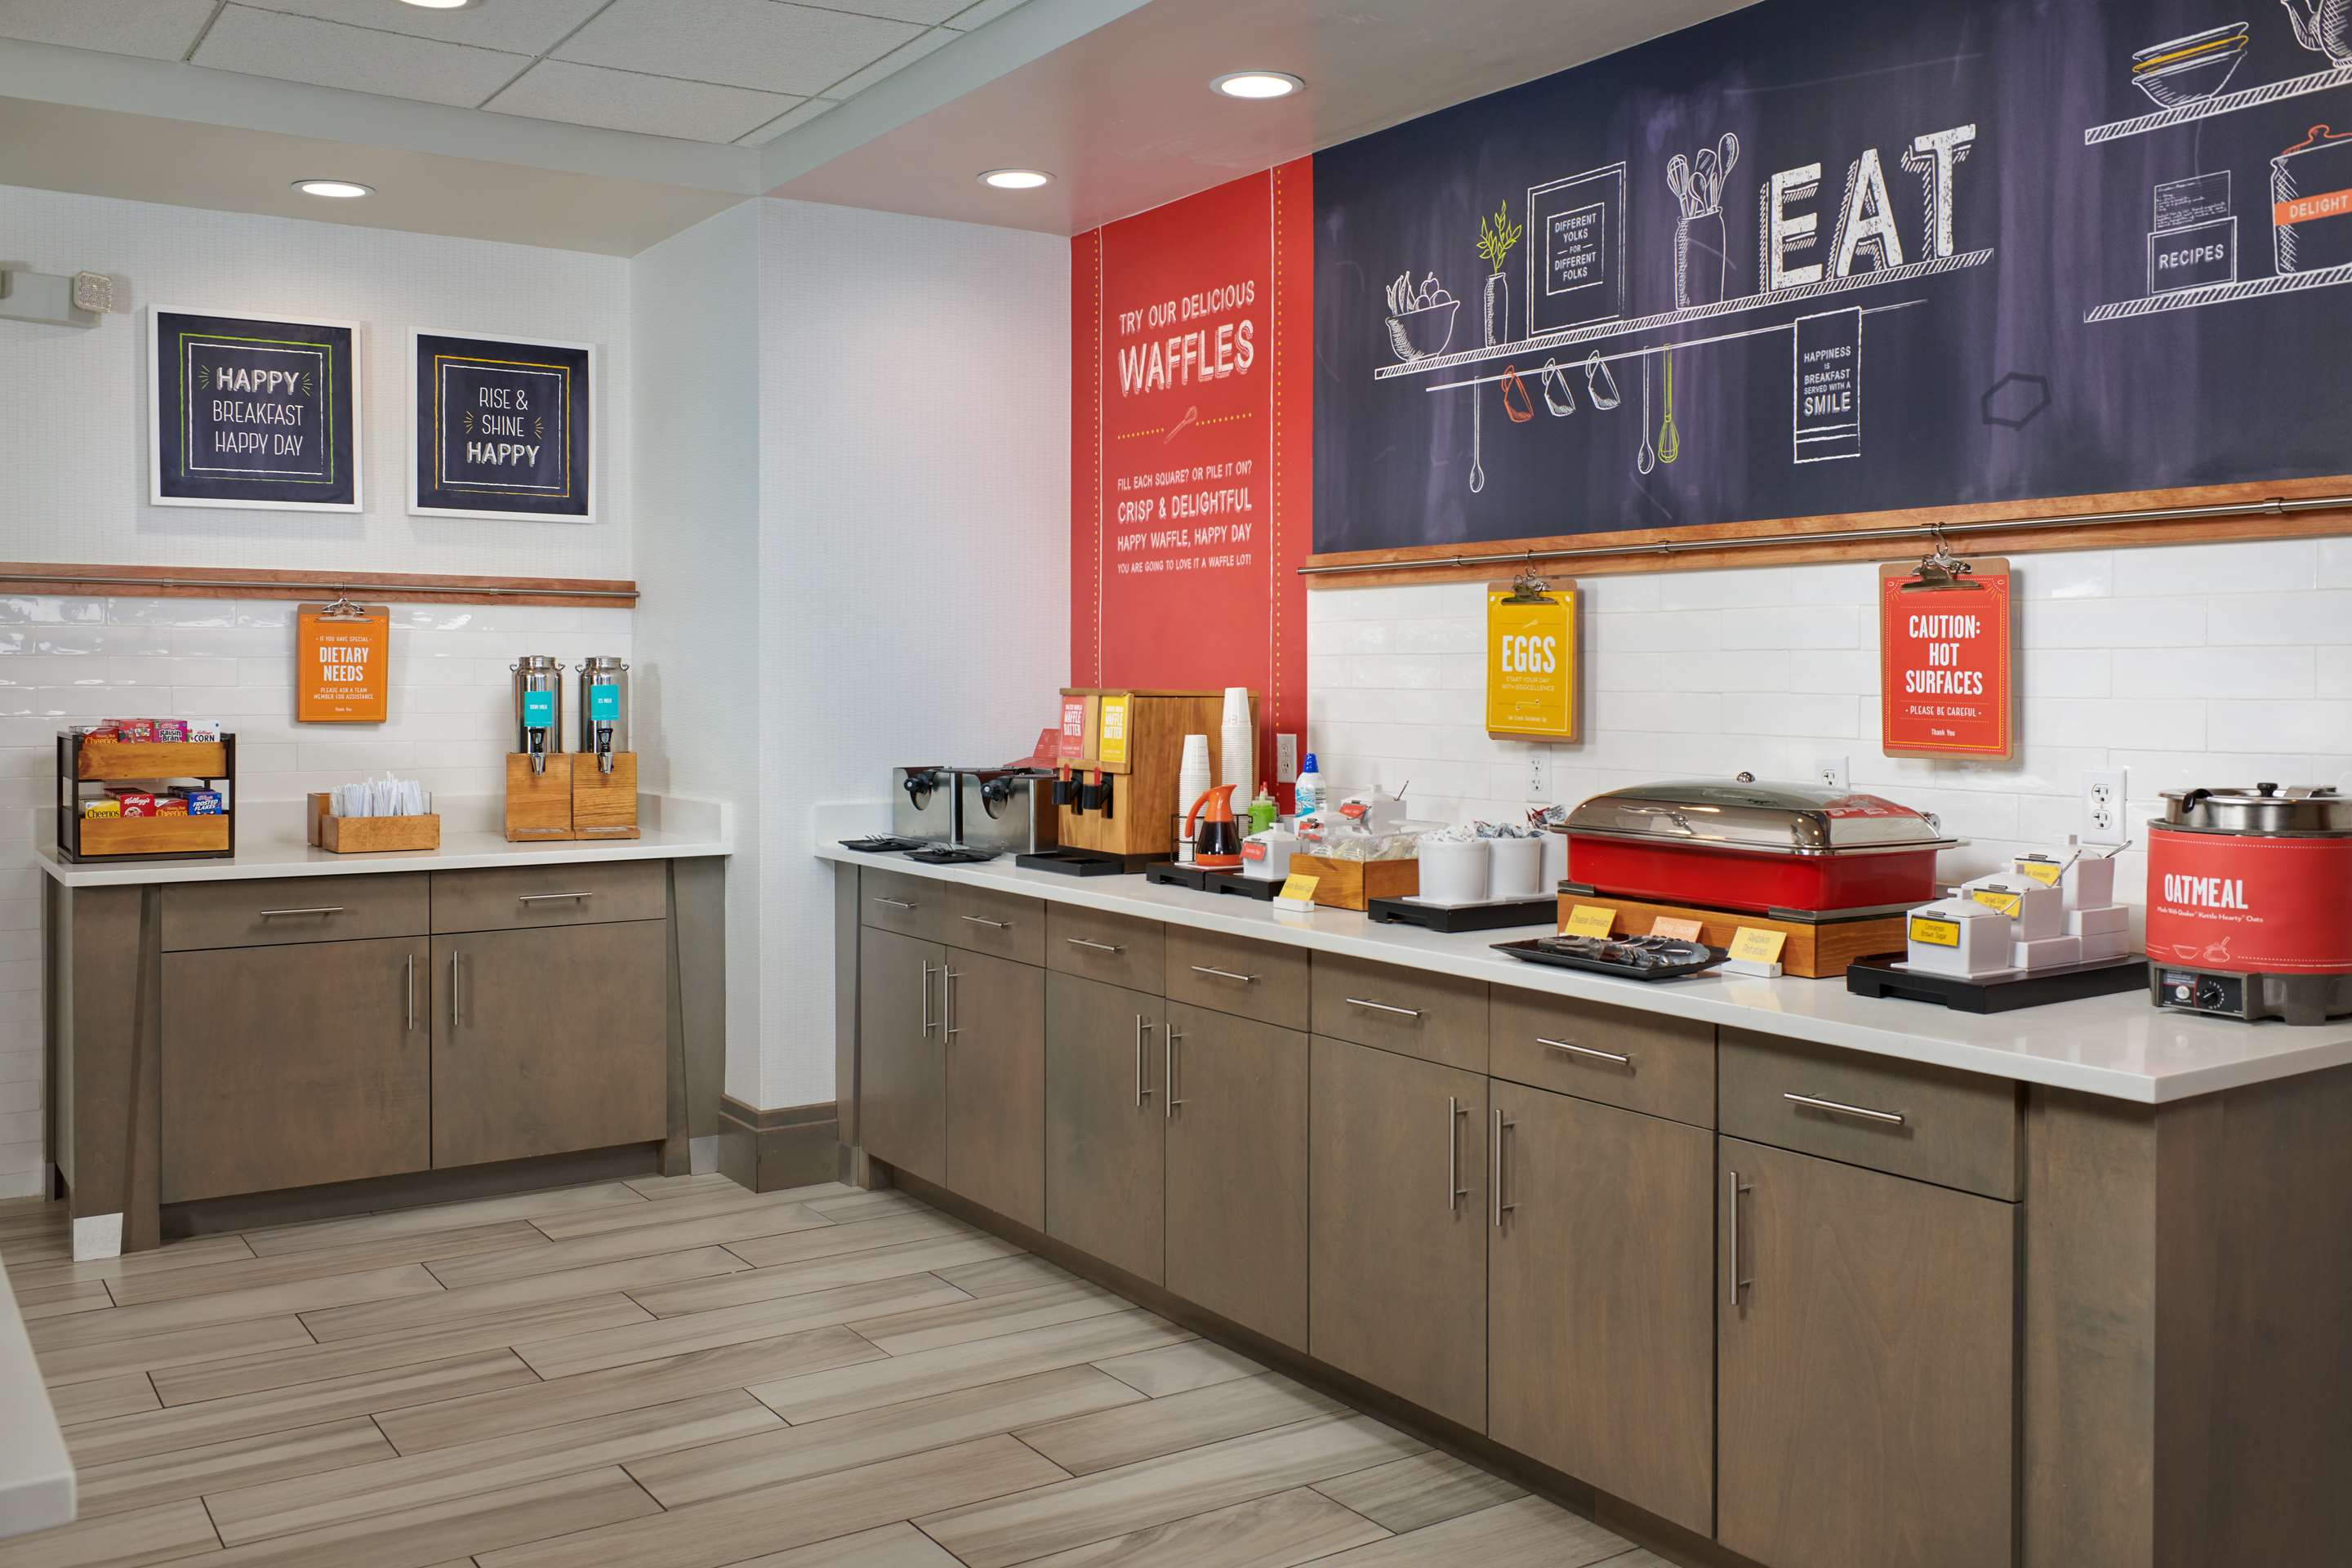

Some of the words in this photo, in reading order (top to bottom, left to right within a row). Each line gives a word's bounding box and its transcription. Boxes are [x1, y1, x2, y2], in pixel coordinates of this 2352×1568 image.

[1759, 122, 1977, 293] EAT
[2290, 195, 2349, 217] DELIGHT
[1555, 212, 1597, 233] DIFFERENT
[1563, 228, 1588, 243] YOLKS
[1569, 244, 1582, 253] FOR
[2158, 243, 2225, 270] RECIPES
[1554, 252, 1597, 271] DIFFERENT
[1562, 266, 1588, 282] FOLKS
[1119, 308, 1143, 336] TRY
[1148, 300, 1177, 329] OUR
[1181, 279, 1255, 322] DELICIOUS
[1117, 319, 1254, 398] WAFFLES
[1803, 345, 1851, 363] HAPPINESS
[1803, 368, 1851, 385] BREAKFAST
[1824, 362, 1830, 370] IS
[216, 367, 300, 395] HAPPY
[1803, 384, 1828, 395] SERVED
[1829, 381, 1845, 391] WITH
[1846, 381, 1851, 389] A
[479, 387, 511, 409] RISE
[515, 390, 528, 411] &
[1803, 391, 1851, 417] SMILE
[213, 399, 305, 426] BREAKFAST
[482, 414, 525, 437] SHINE
[216, 430, 268, 455] HAPPY
[274, 434, 303, 456] DAY
[466, 441, 540, 468] HAPPY
[1117, 477, 1131, 491] FILL
[1134, 474, 1153, 489] EACH
[1155, 469, 1189, 487] SQUARE?
[1192, 467, 1204, 481] OR
[1205, 464, 1223, 479] PILE
[1225, 462, 1233, 476] IT
[1235, 459, 1253, 475] ON?
[1117, 499, 1154, 524] CRISP
[1158, 496, 1167, 520] &
[1170, 487, 1253, 520] DELIGHTFUL
[1117, 533, 1147, 553] HAPPY
[1150, 529, 1192, 550] WAFFLE,
[1194, 525, 1228, 546] HAPPY
[1231, 523, 1253, 543] DAY
[1117, 563, 1129, 575] YOU
[1131, 561, 1143, 573] ARE
[1144, 559, 1164, 572] GOING
[1165, 559, 1174, 571] TO
[1175, 558, 1192, 570] LOVE
[1193, 557, 1200, 569] IT
[1200, 556, 1207, 568] A
[1208, 555, 1235, 568] WAFFLE
[1236, 554, 1252, 566] LOT!
[1908, 614, 1981, 639] CAUTION:
[319, 646, 369, 664] DIETARY
[1501, 635, 1556, 674] EGGS
[1928, 642, 1960, 667] HOT
[323, 665, 363, 682] NEEDS
[1904, 669, 1984, 696] SURFACES
[1064, 710, 1082, 724] WAFFLE
[1909, 705, 1935, 715] PLEASE
[1936, 706, 1945, 716] BE
[1947, 706, 1977, 718] CAREFUL
[84, 736, 118, 744] Cheerios
[160, 728, 181, 737] Raisin
[194, 734, 215, 742] CORN
[1931, 728, 1945, 736] Thank
[123, 796, 151, 805] Kellogg's
[193, 799, 219, 807] FROSTED
[87, 809, 119, 818] Cheerios
[155, 808, 188, 817] Cheerios
[2164, 873, 2249, 910] OATMEAL
[2198, 911, 2218, 920] Kettle
[2246, 915, 2264, 923] Oats
